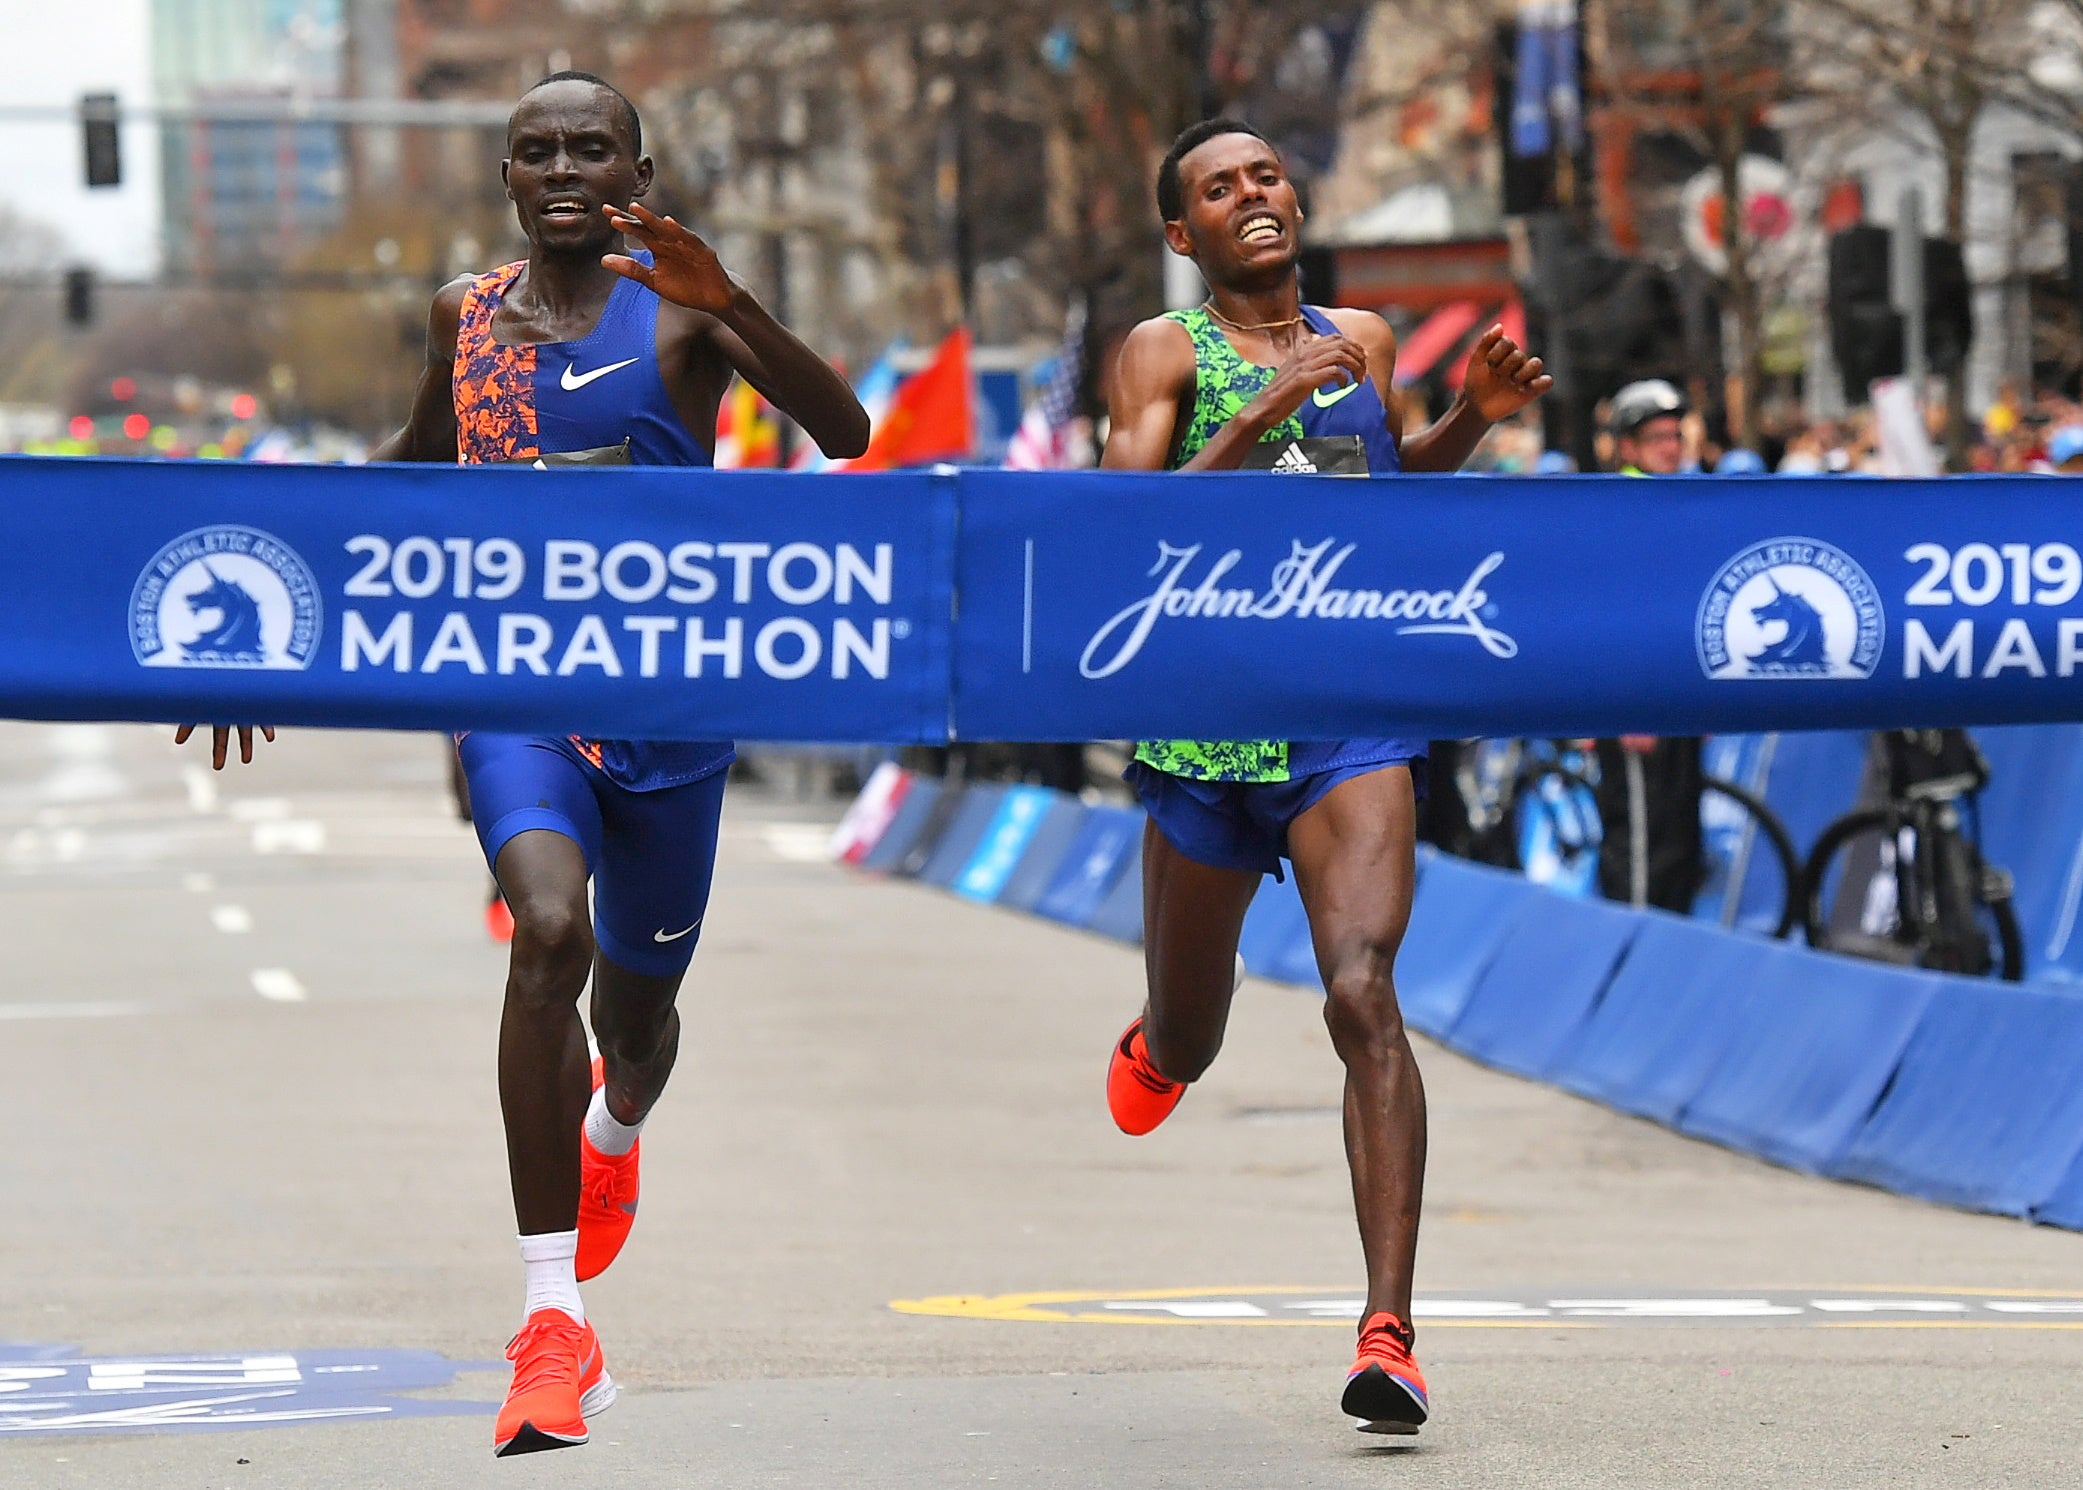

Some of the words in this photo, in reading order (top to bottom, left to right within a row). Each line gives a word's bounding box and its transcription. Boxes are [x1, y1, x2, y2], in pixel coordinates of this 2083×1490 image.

[1271, 463, 1318, 475] adidas
[343, 535, 525, 600] 2019
[543, 540, 893, 605] BOSTON
[1904, 541, 2083, 606] 2019
[1079, 540, 1254, 679] John
[1252, 537, 1518, 659] Hancock
